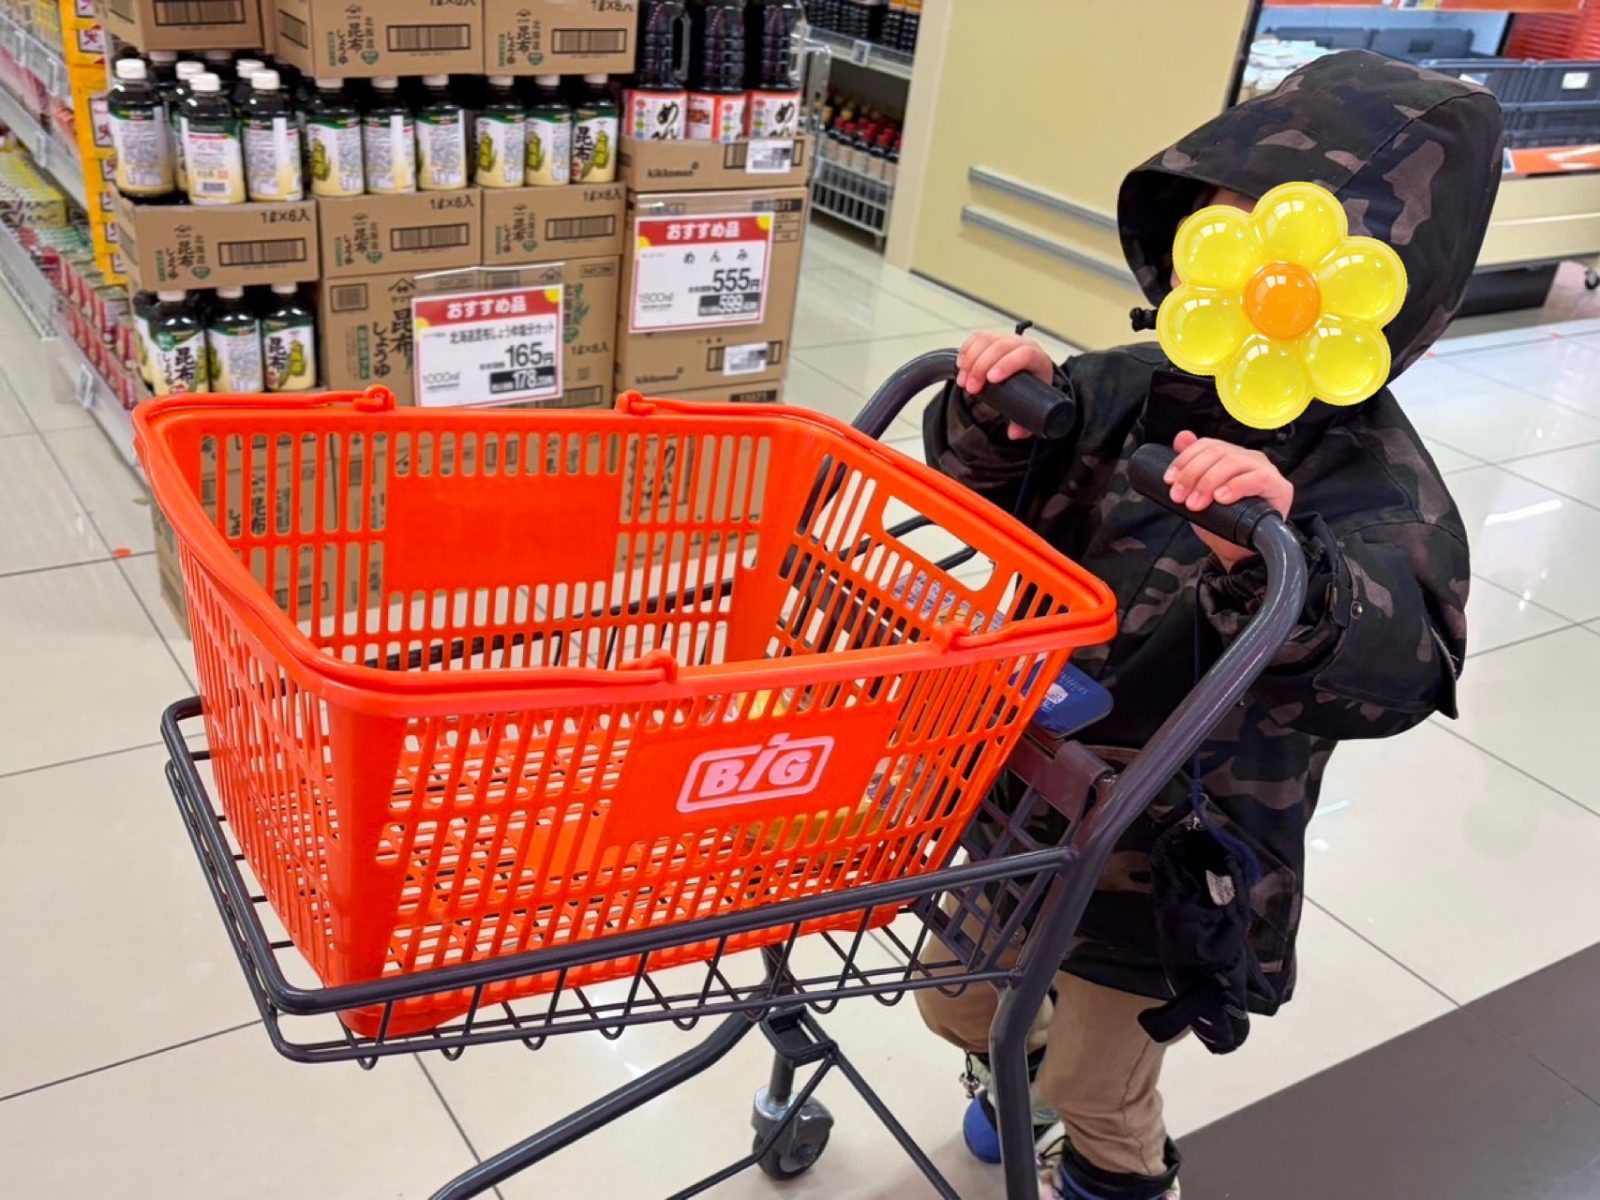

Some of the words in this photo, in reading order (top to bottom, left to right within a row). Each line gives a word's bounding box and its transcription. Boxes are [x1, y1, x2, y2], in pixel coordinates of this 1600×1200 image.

[575, 126, 593, 161] 昆布
[666, 221, 741, 241] おすすめ品
[446, 295, 528, 320] おすすめ品
[174, 346, 195, 383] 昆布
[268, 336, 288, 371] 昆布
[372, 320, 391, 379] しょうゆ
[698, 733, 813, 798] BIG
